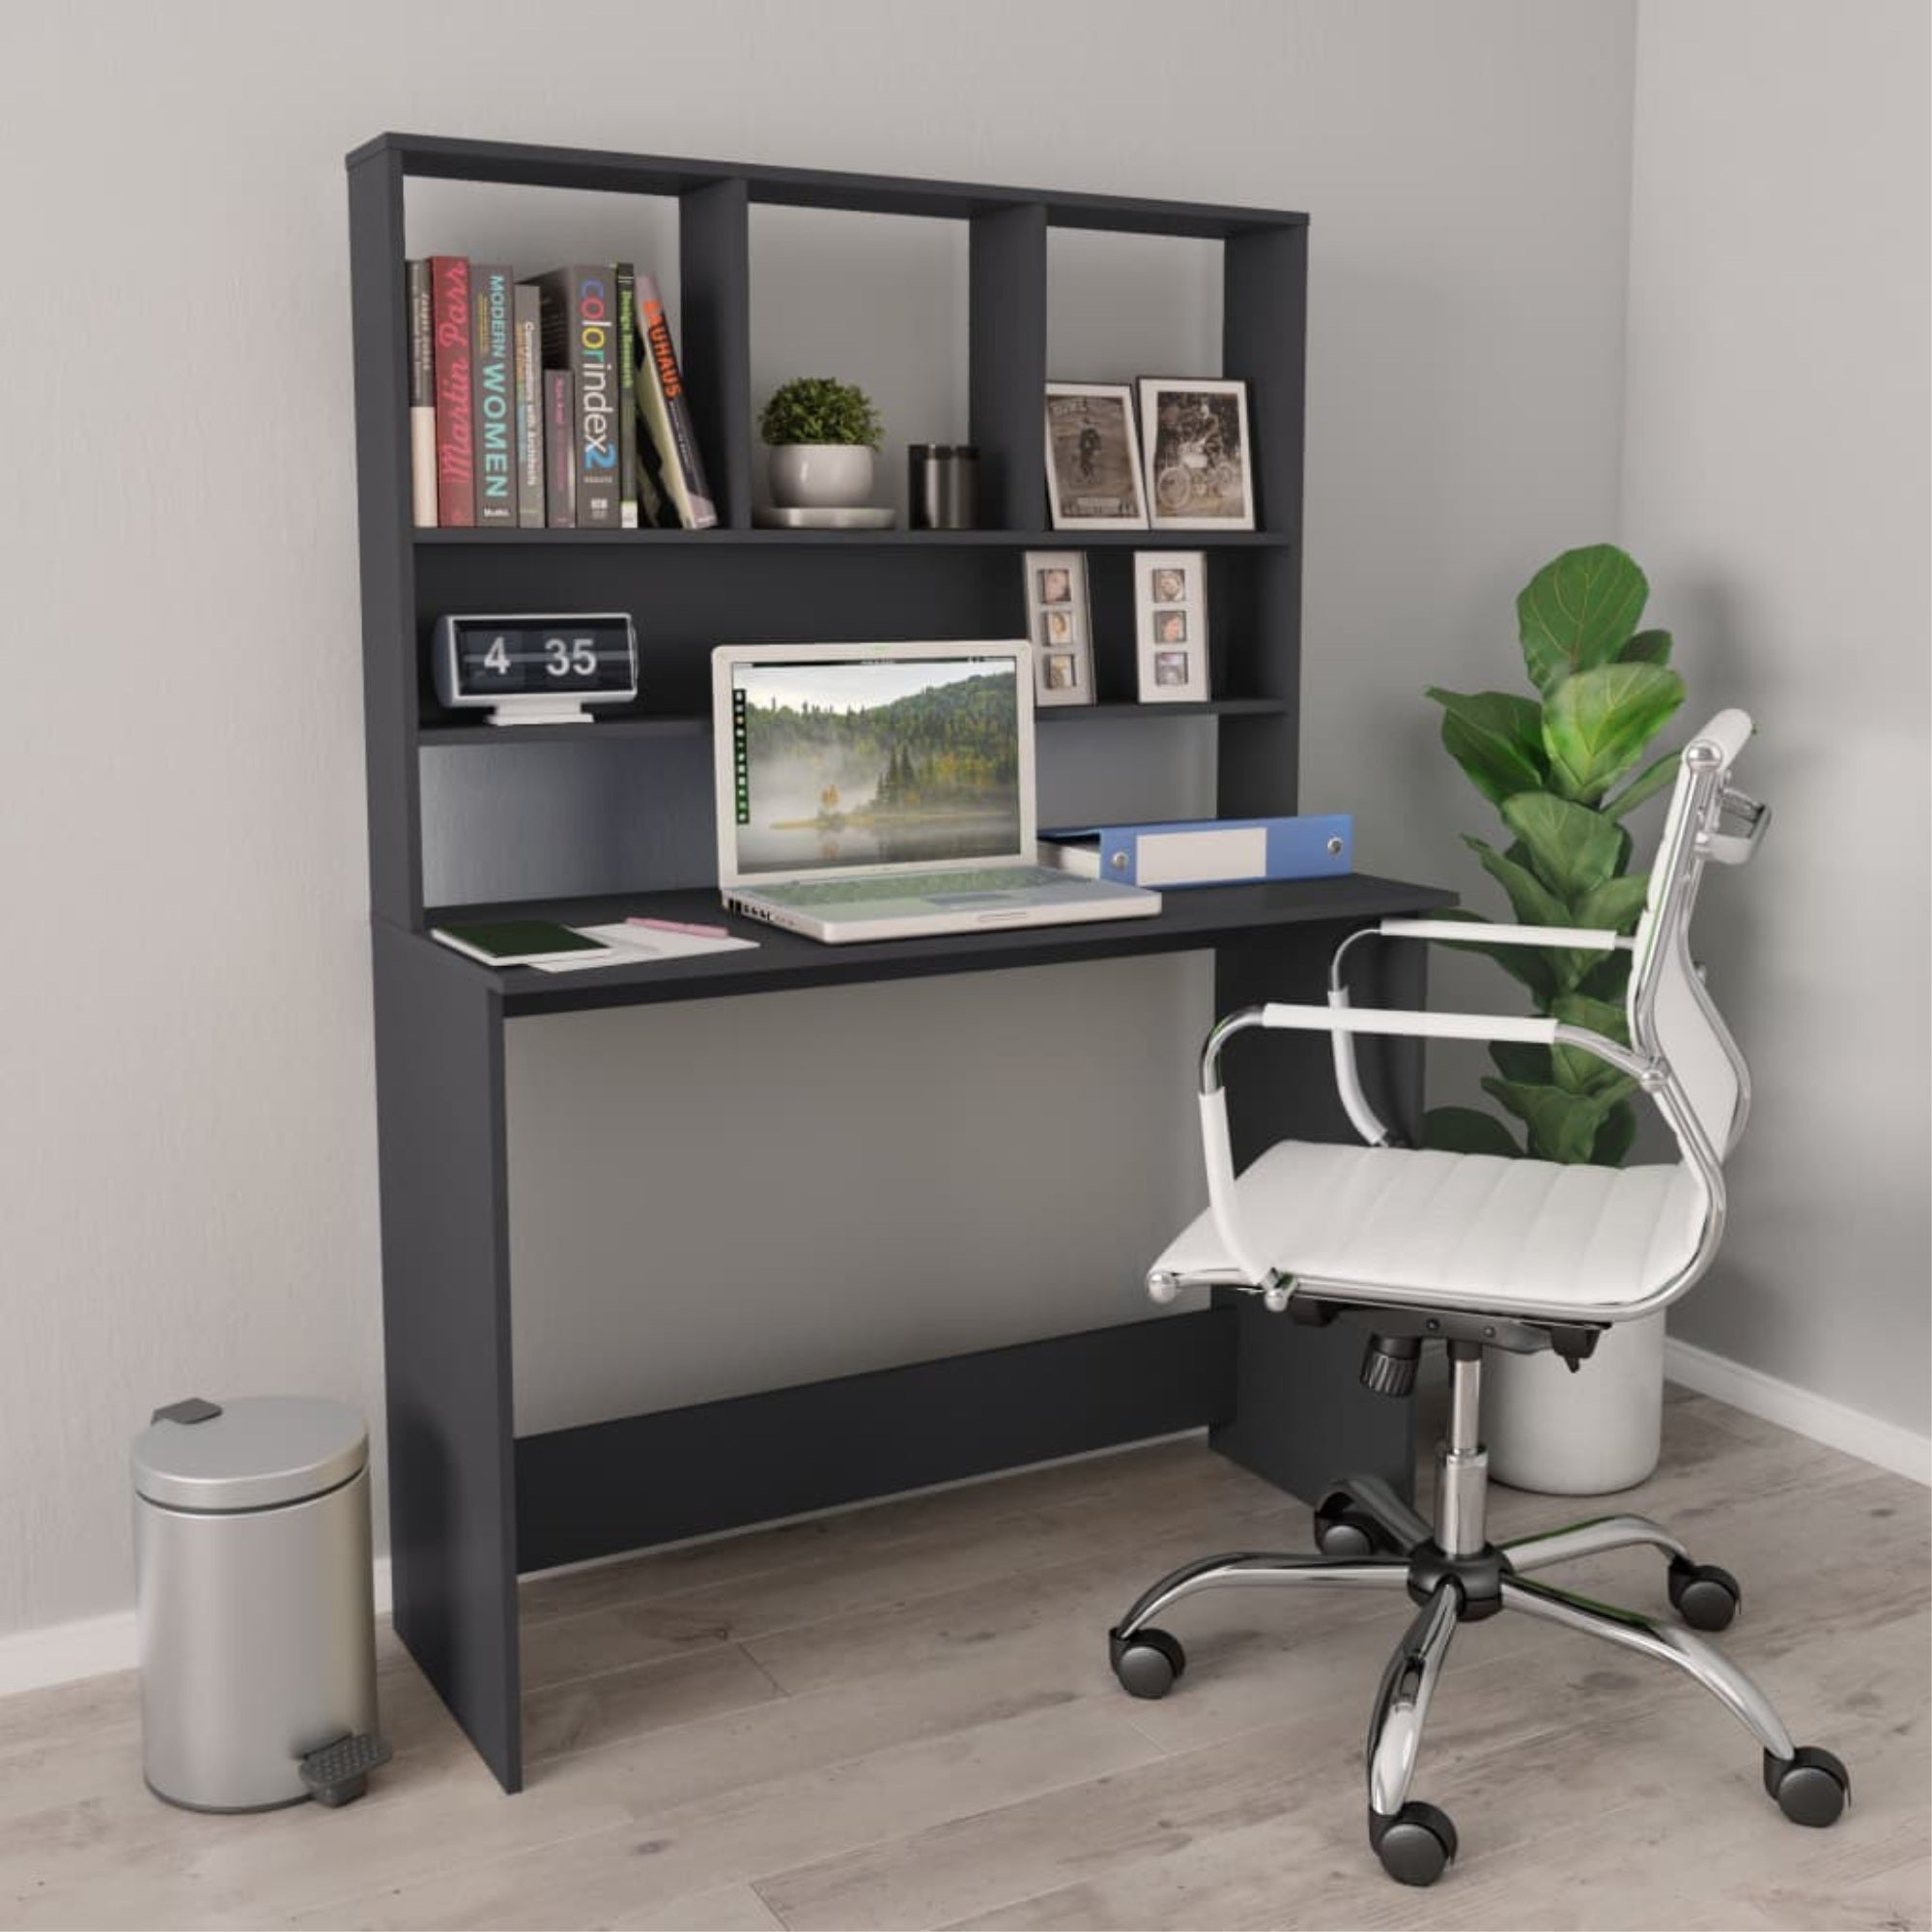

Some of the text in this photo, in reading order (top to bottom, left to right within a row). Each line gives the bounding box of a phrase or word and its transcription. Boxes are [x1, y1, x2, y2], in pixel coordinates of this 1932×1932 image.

[490, 275, 505, 356] MODERN
[642, 299, 682, 400] BAUHAUS
[438, 261, 471, 482] Martin Parr
[483, 362, 508, 497] WOMEN
[484, 637, 597, 675] 4 35
